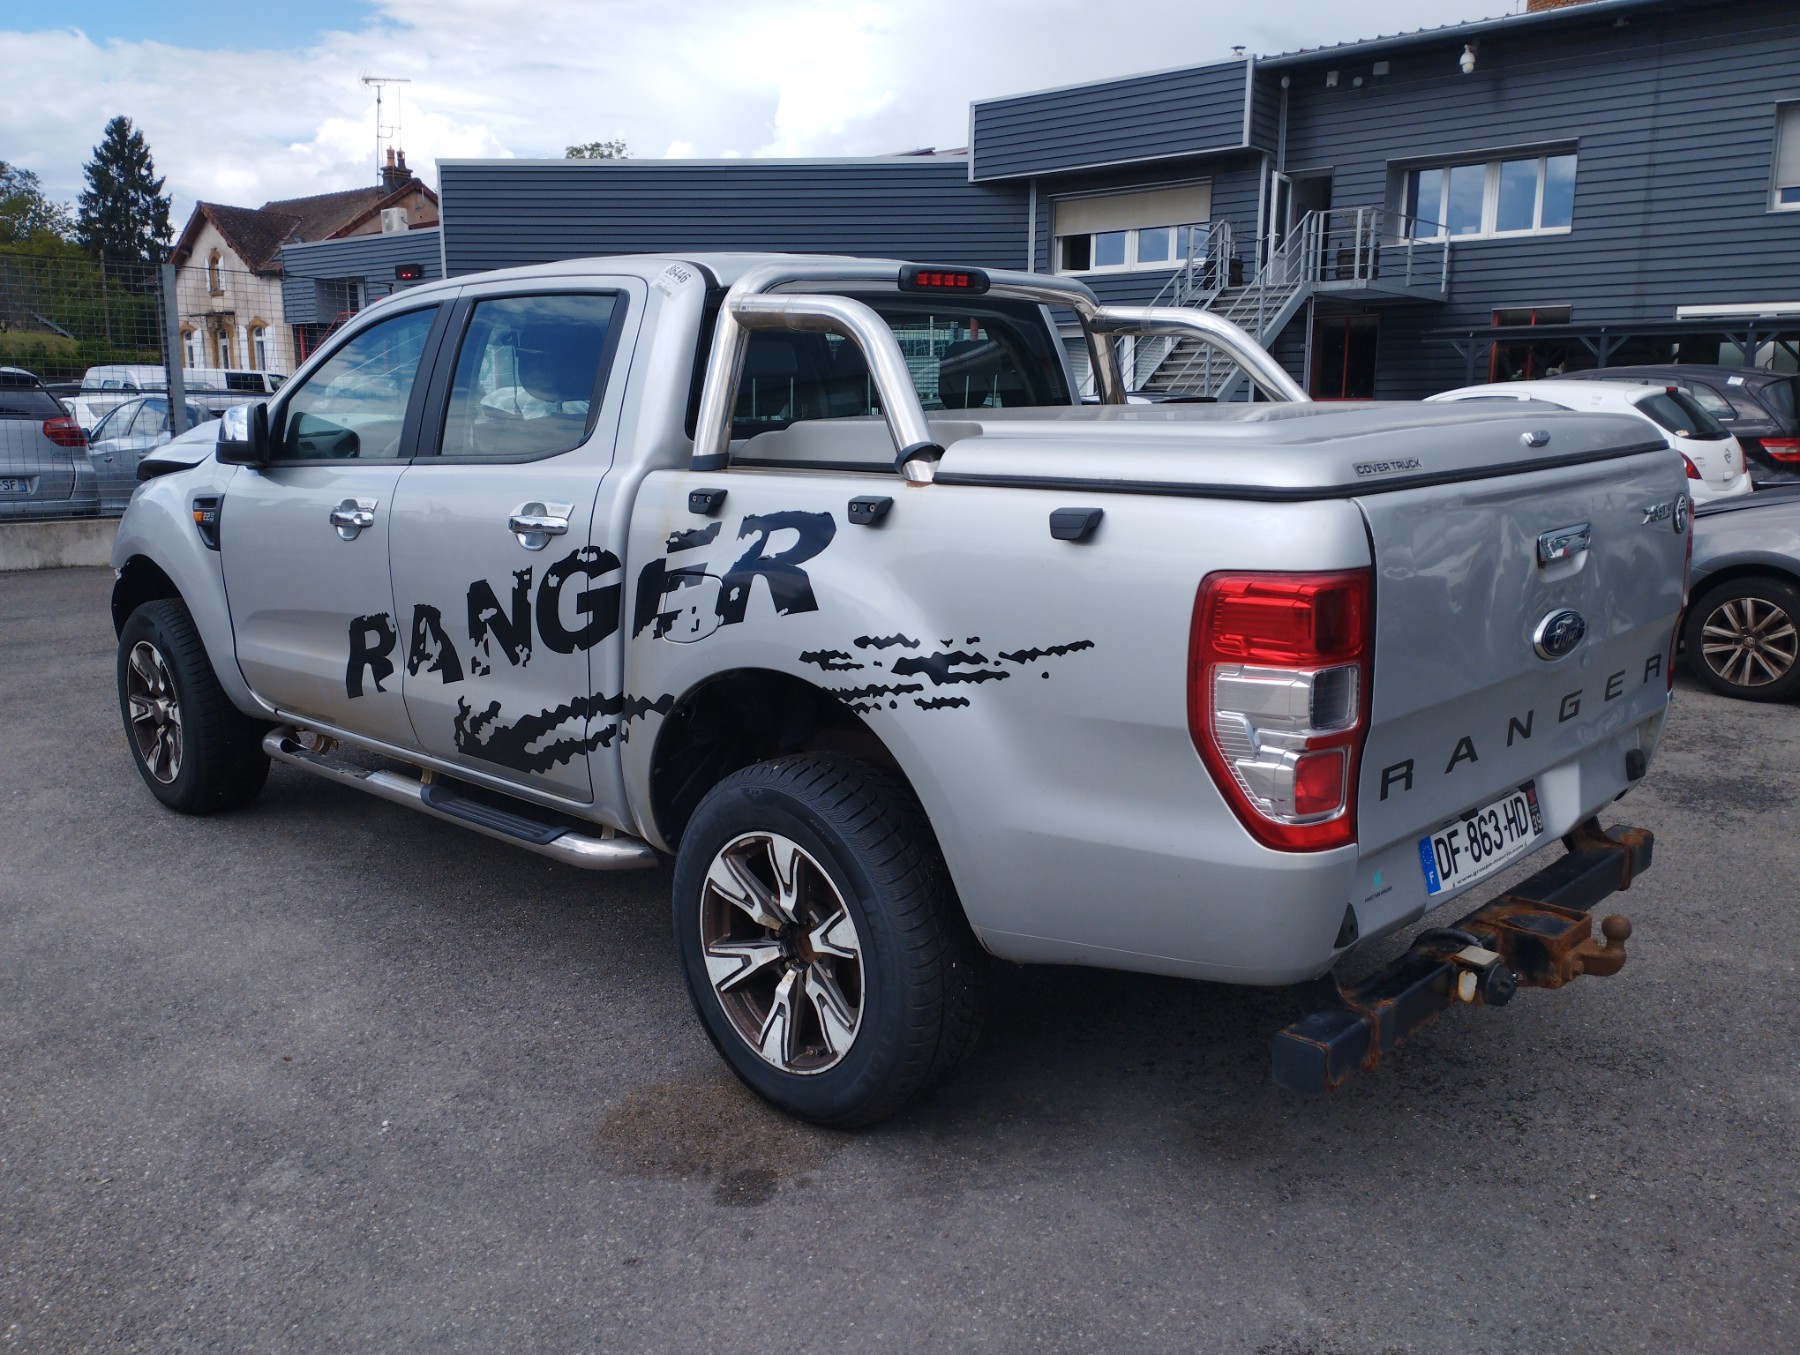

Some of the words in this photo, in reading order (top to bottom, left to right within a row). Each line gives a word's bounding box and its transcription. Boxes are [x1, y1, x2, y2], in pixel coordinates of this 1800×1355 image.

[1356, 463, 1391, 475] COVER
[1390, 458, 1422, 471] TRUCK
[346, 510, 837, 698] RANGER
[1551, 615, 1580, 650] Ford
[1379, 653, 1662, 802] RANGER
[1433, 796, 1529, 881] DF-863-HD
[1531, 813, 1543, 833] 39
[1428, 871, 1435, 885] F
